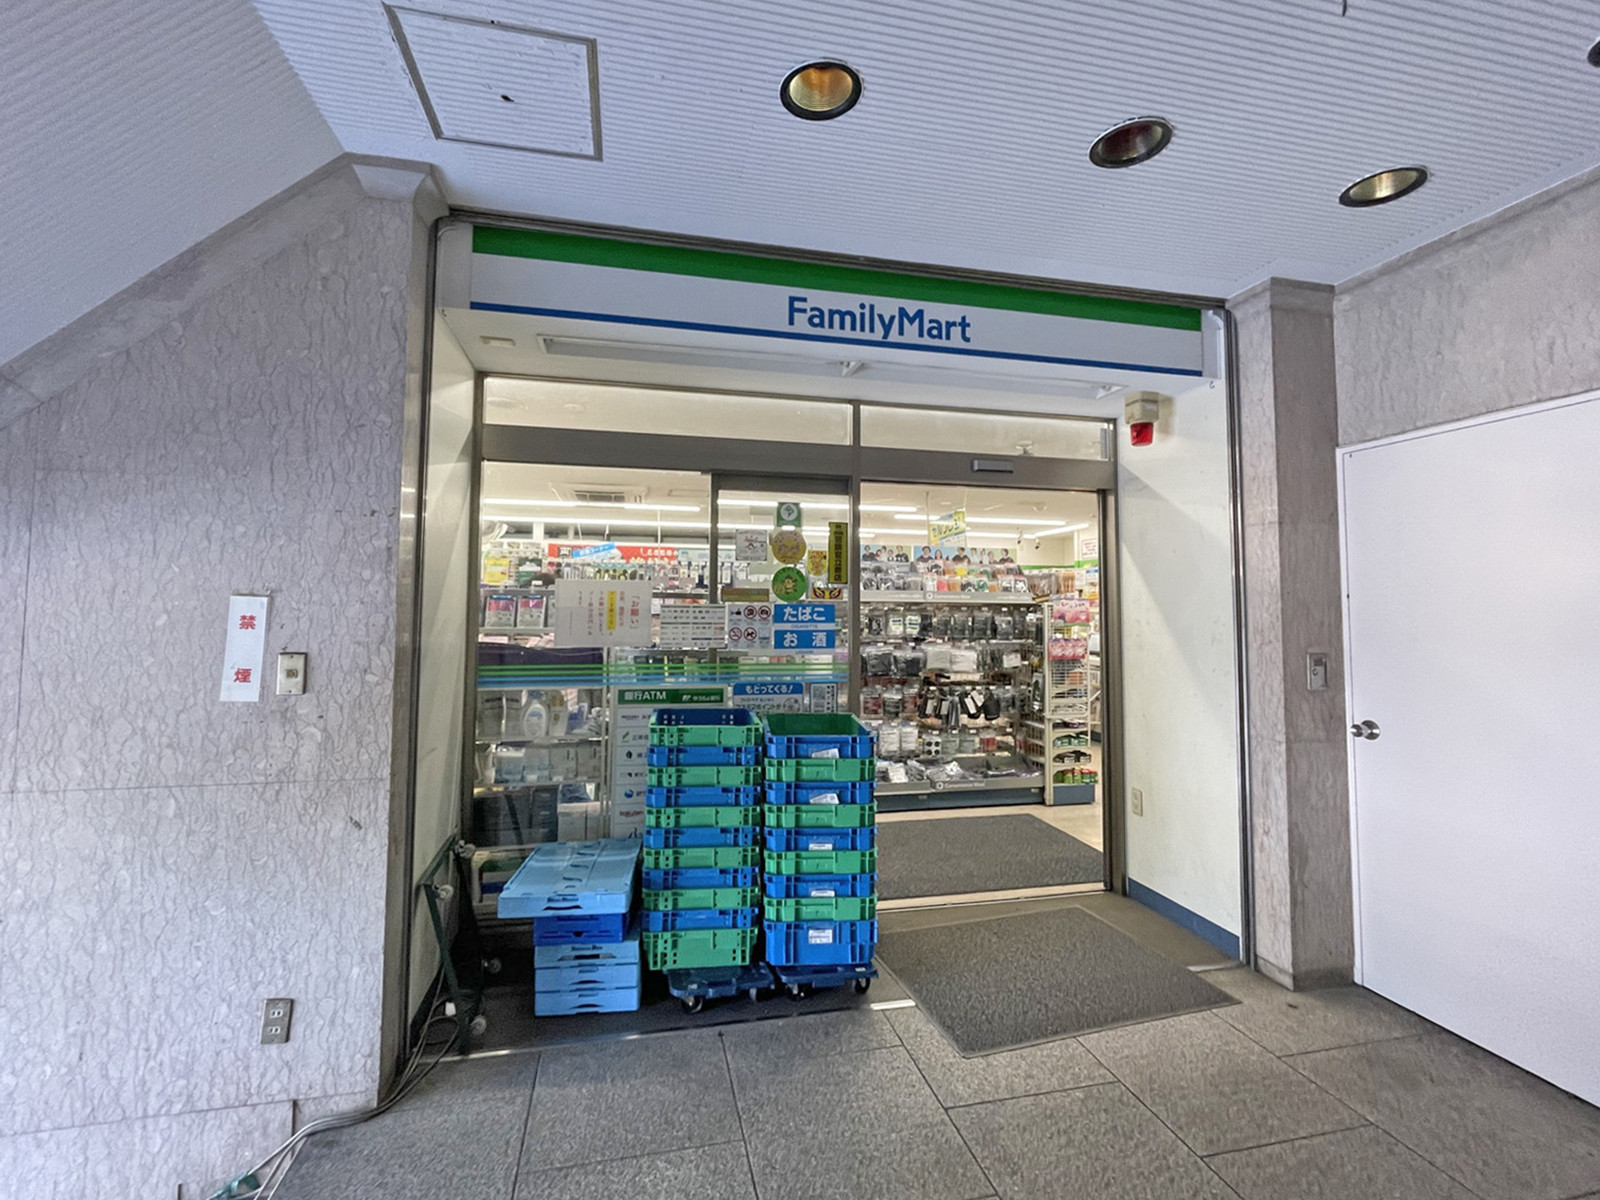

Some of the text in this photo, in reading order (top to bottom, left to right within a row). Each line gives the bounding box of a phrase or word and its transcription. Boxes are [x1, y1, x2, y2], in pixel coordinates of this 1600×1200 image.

[788, 296, 971, 343] FamilyMart
[783, 606, 826, 621] たばこ
[624, 690, 667, 700] 銀行ATM
